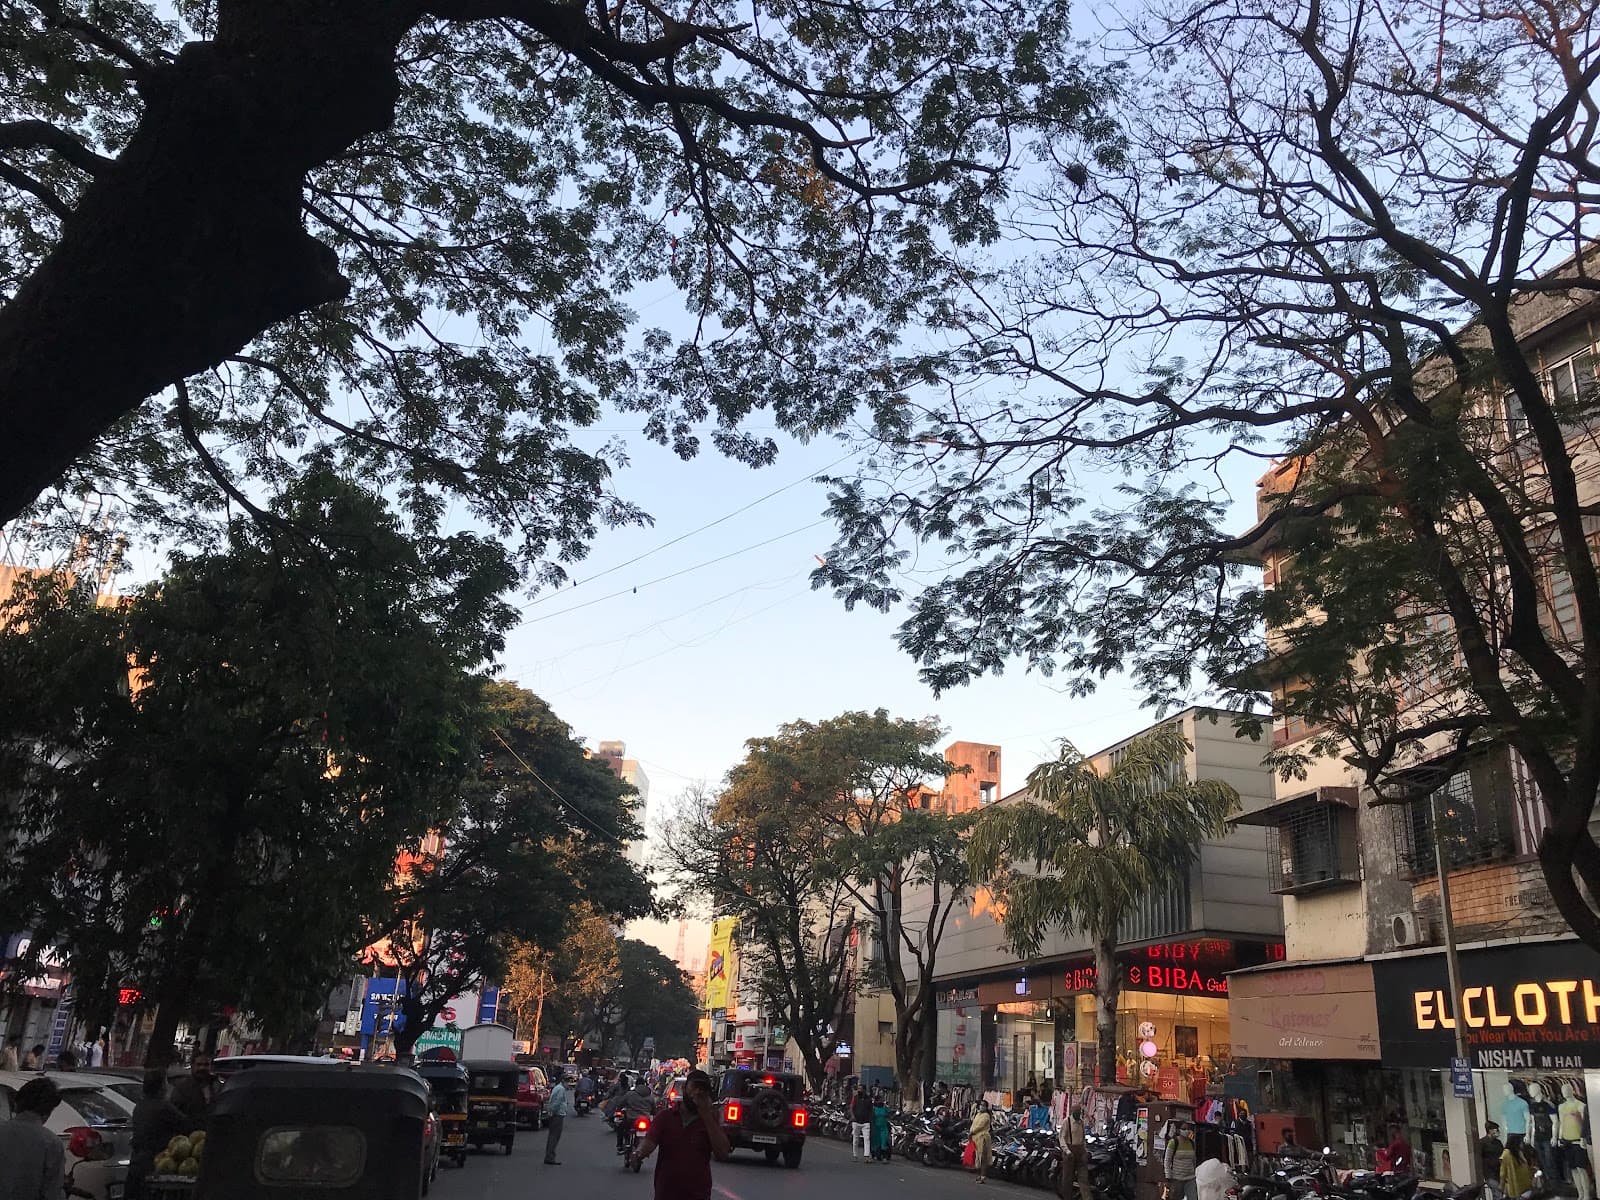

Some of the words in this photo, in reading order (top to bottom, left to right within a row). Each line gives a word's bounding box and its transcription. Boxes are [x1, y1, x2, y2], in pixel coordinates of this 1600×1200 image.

[1148, 966, 1203, 991] BIBA
[1466, 1033, 1478, 1045] ou
[1479, 1030, 1505, 1044] Wear
[1507, 1029, 1537, 1043] What
[1539, 1028, 1562, 1042] You
[1565, 1027, 1588, 1041] Are
[1478, 1049, 1535, 1068] NISHAT
